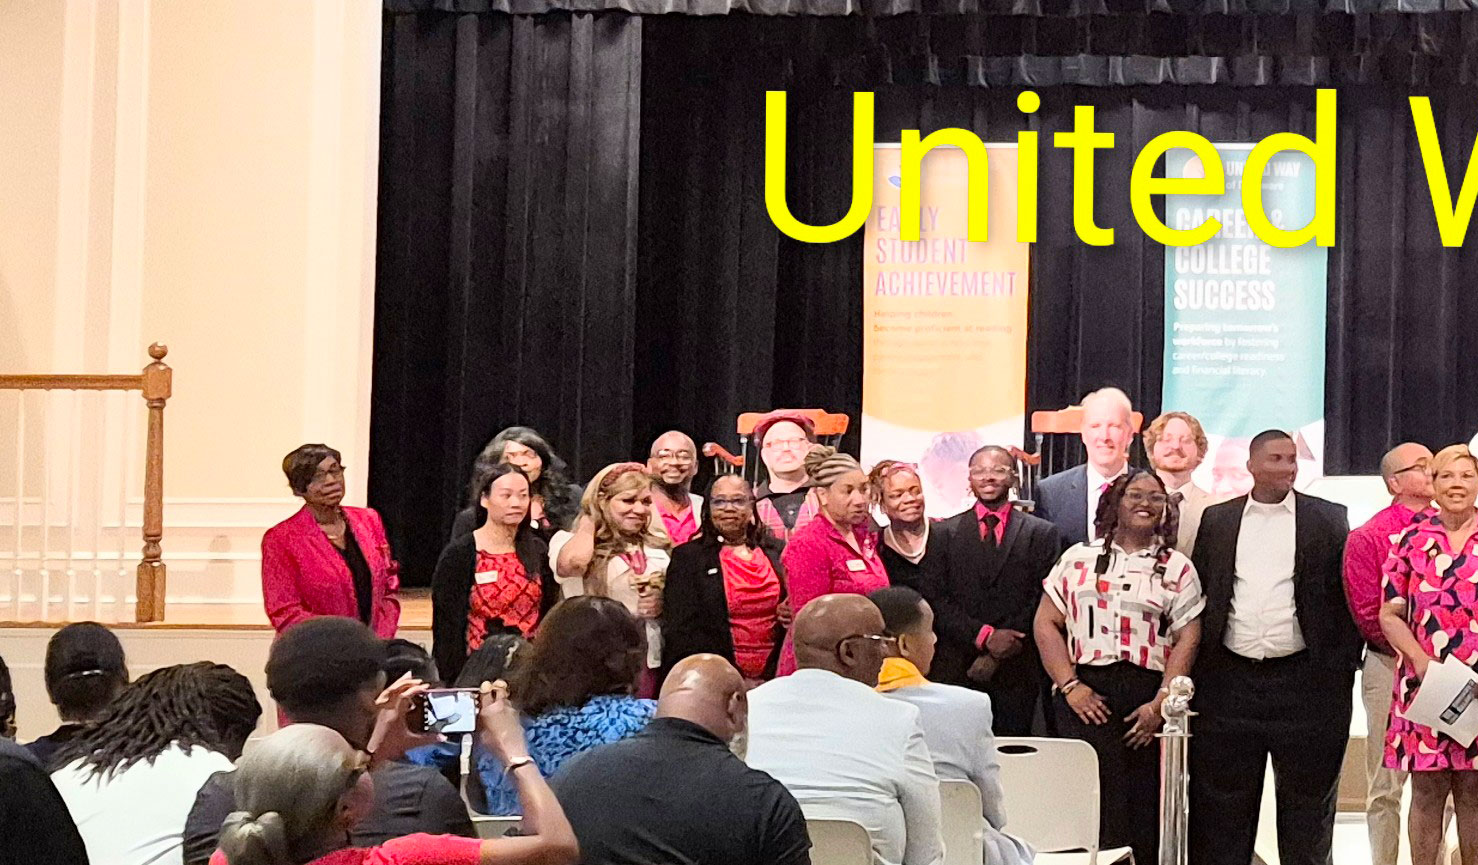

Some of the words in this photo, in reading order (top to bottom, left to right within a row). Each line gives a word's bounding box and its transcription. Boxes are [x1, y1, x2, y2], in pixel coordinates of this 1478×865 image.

[1273, 161, 1300, 177] WAY
[877, 206, 938, 233] EALY
[876, 237, 968, 265] STUDENT
[1175, 245, 1271, 274] COLLEGE
[875, 270, 1016, 297] ACHIEVEMENT
[1174, 279, 1276, 311] SUCCESS
